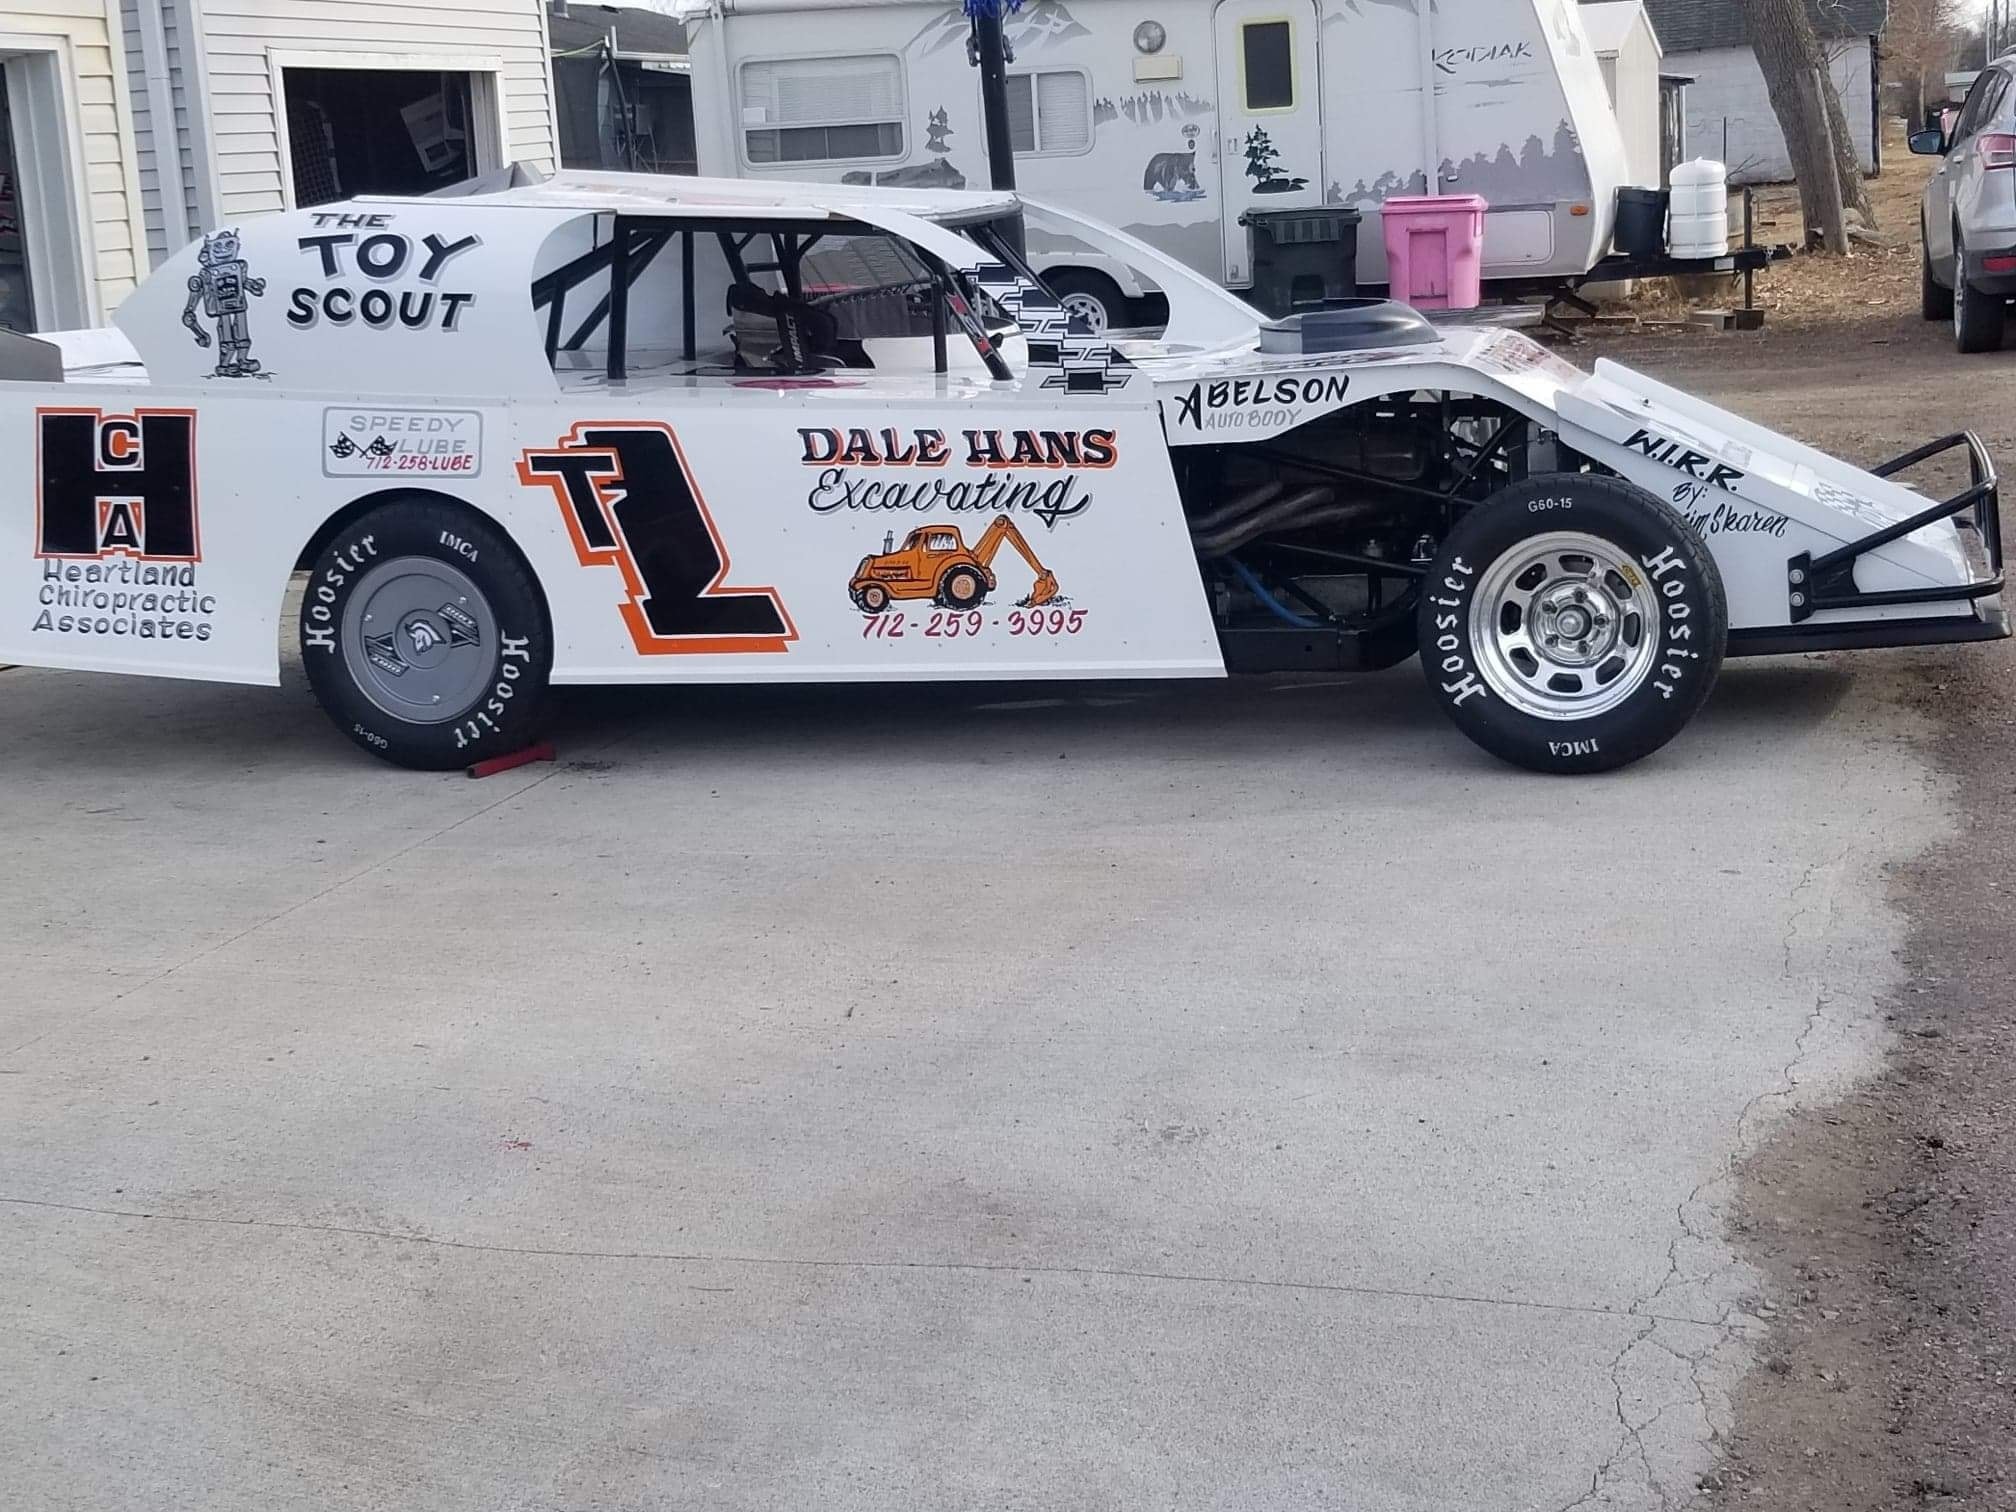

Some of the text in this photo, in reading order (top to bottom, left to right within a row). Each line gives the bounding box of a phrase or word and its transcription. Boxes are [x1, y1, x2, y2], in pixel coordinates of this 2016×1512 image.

[1431, 41, 1532, 74] KODIAK
[310, 212, 396, 230] THE
[297, 232, 484, 286] TOY
[286, 286, 477, 332] SCOUT
[1174, 374, 1350, 431] ABELSON
[1204, 408, 1302, 430] AUTO BODY
[349, 415, 464, 432] SPEEDY
[396, 438, 467, 454] LUBE
[796, 427, 1118, 469] DALE HANS
[807, 467, 1093, 532] Excavating
[1528, 497, 1573, 514] G60-15
[438, 530, 480, 563] IMCA
[42, 559, 197, 587] Heartland
[39, 583, 217, 615] Chiropractic
[305, 534, 378, 654] Hoosier
[32, 608, 213, 641] Associates
[1429, 555, 1487, 707] Hoosier
[1641, 545, 1699, 700] Hoosier
[453, 629, 531, 749] Hoosier
[1548, 737, 1600, 757] IMCA
